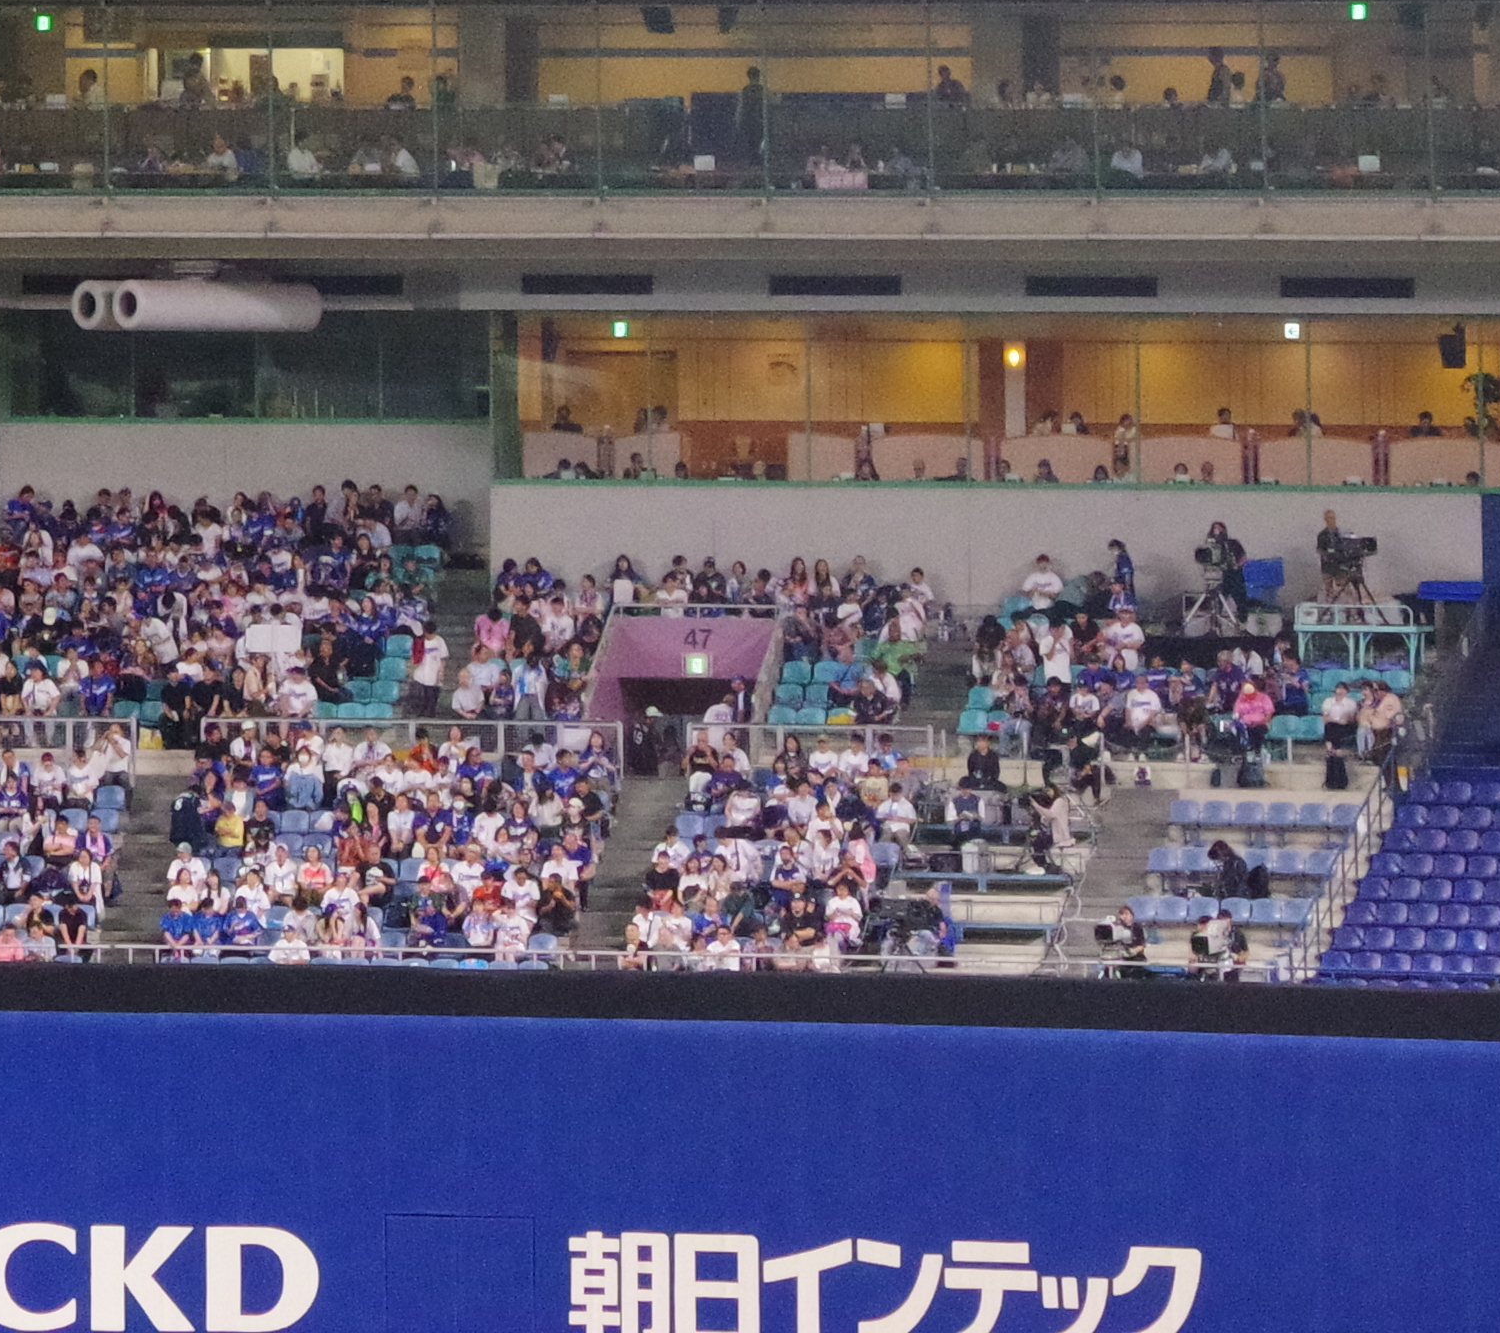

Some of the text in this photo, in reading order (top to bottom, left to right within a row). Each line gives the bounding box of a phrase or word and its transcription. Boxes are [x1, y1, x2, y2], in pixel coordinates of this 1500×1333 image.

[683, 628, 713, 649] 47
[567, 1230, 1202, 1333] 朝日インテック
